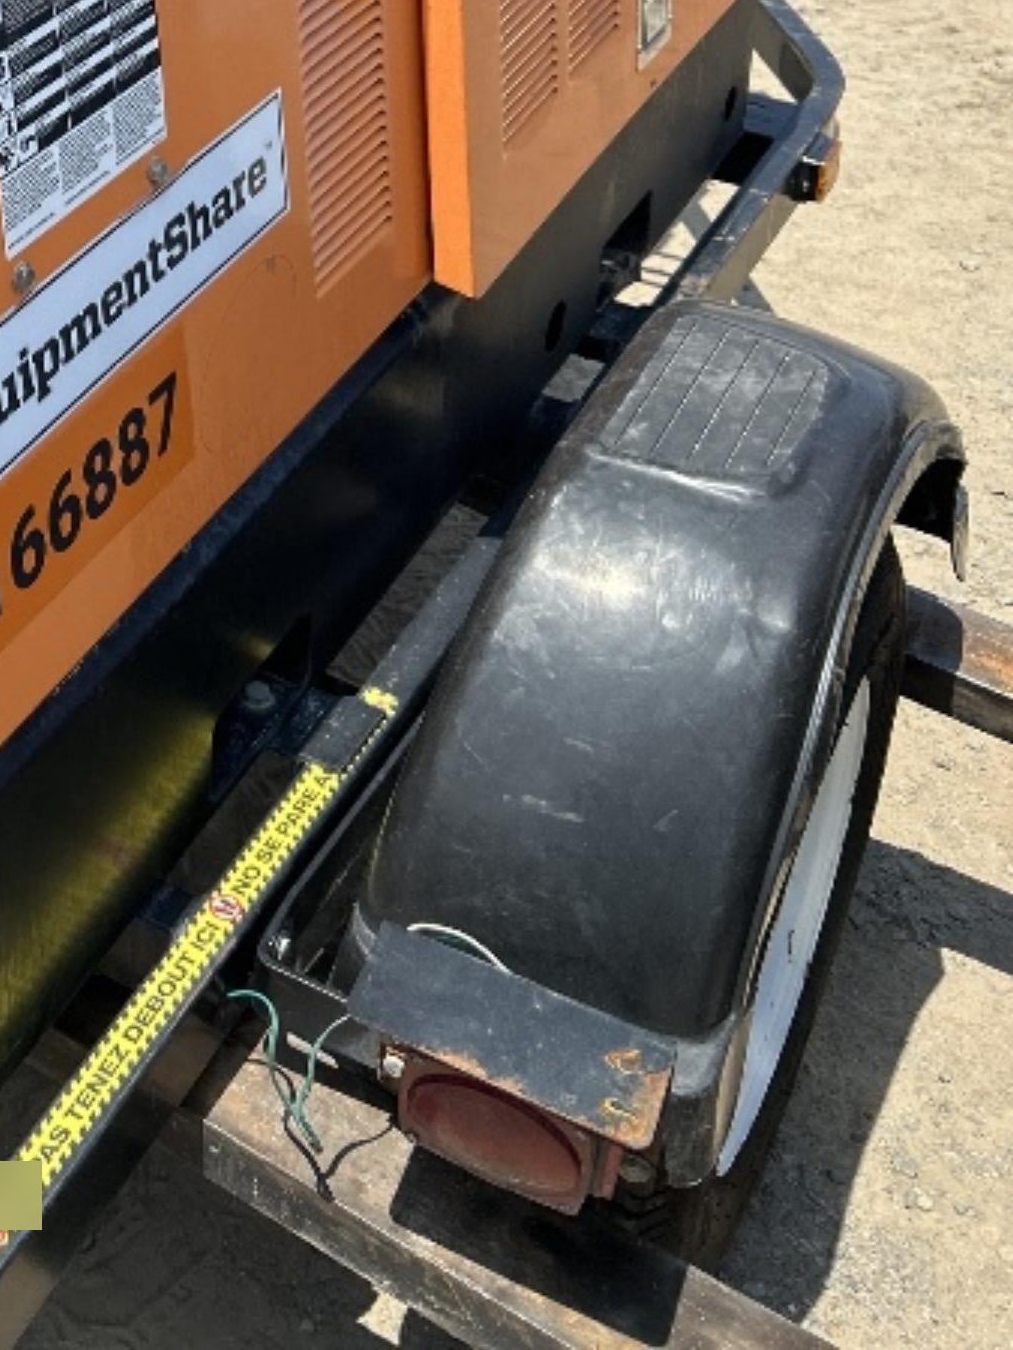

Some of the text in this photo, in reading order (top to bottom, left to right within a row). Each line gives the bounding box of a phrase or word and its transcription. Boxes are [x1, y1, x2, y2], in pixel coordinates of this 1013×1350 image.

[230, 864, 262, 897] NO
[256, 836, 283, 865] SE
[275, 788, 319, 837] PARE
[64, 1045, 129, 1122] TENEZ
[123, 953, 196, 1046] DEBOUT
